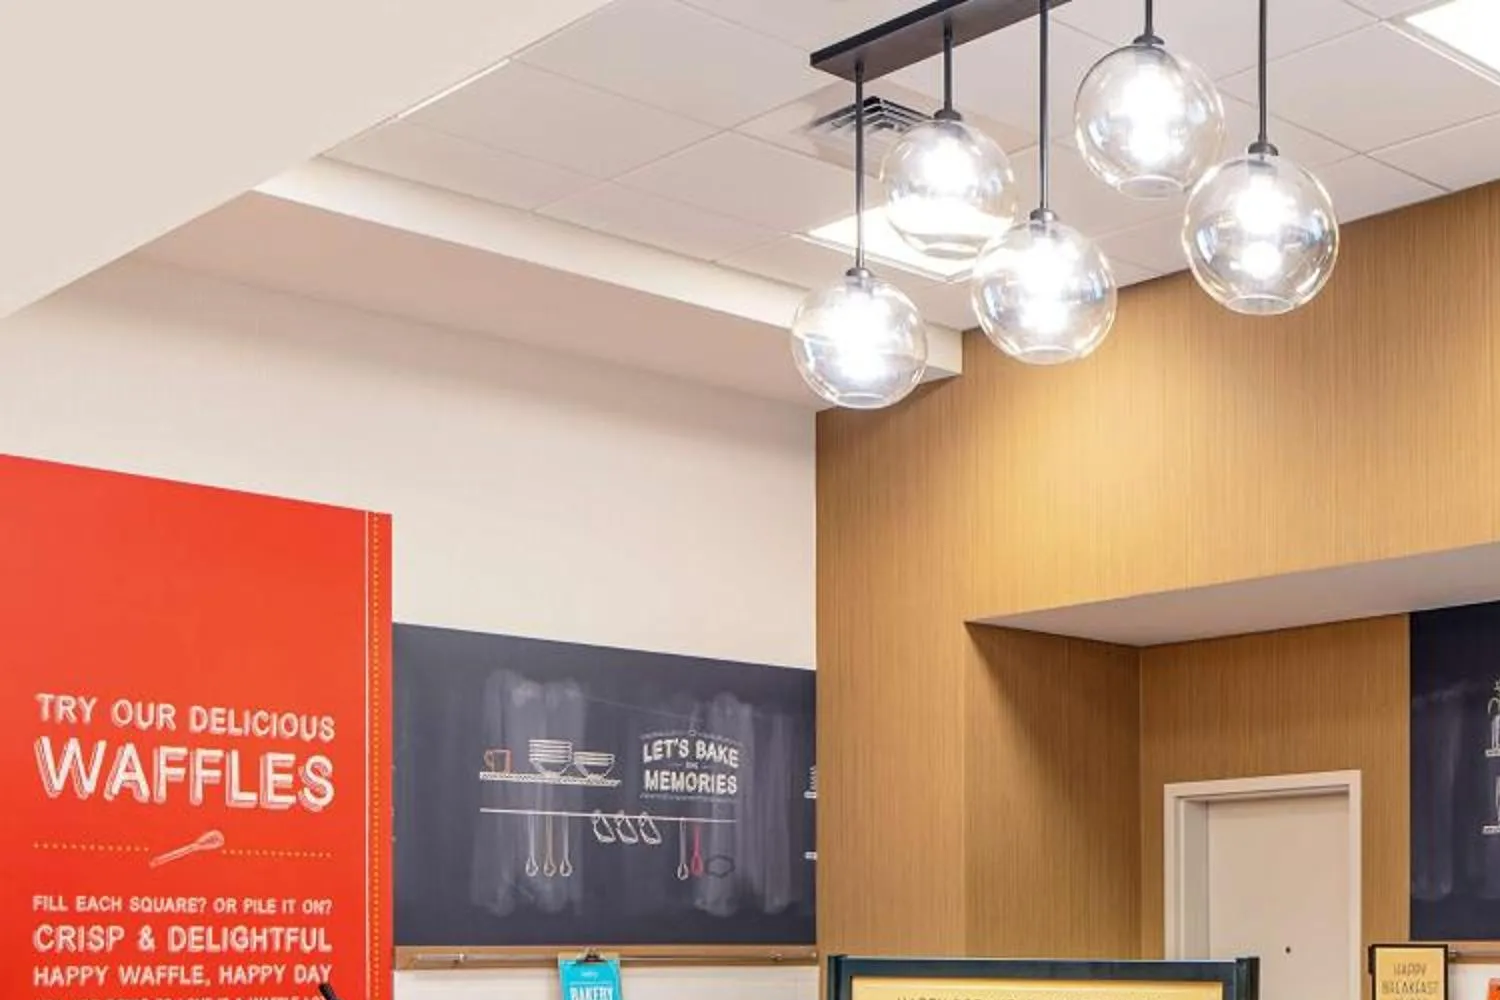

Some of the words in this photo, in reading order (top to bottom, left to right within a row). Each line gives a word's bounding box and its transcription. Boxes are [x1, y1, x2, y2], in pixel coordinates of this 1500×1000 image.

[36, 692, 97, 723] TRY
[111, 700, 176, 731] OUR
[189, 706, 335, 742] DELICIOUS
[643, 738, 689, 763] LET'S
[695, 739, 739, 769] BAKE
[33, 736, 335, 812] WAFFLES
[644, 769, 738, 795] MEMORIES
[33, 896, 68, 912] FILL
[76, 896, 122, 913] EACH
[129, 896, 206, 914] SQUARE?
[213, 897, 237, 914] OR
[243, 898, 276, 914] PILE
[281, 898, 295, 914] IT
[302, 898, 332, 915] ON?
[33, 924, 124, 952] CRISP
[138, 925, 155, 952] &
[168, 925, 332, 952] DELIGHTFUL
[33, 965, 108, 987] HAPPY
[118, 965, 211, 988] WAFFLE,
[219, 964, 287, 986] HAPPY
[294, 963, 332, 985] DAY
[1393, 963, 1427, 976] HAPPY
